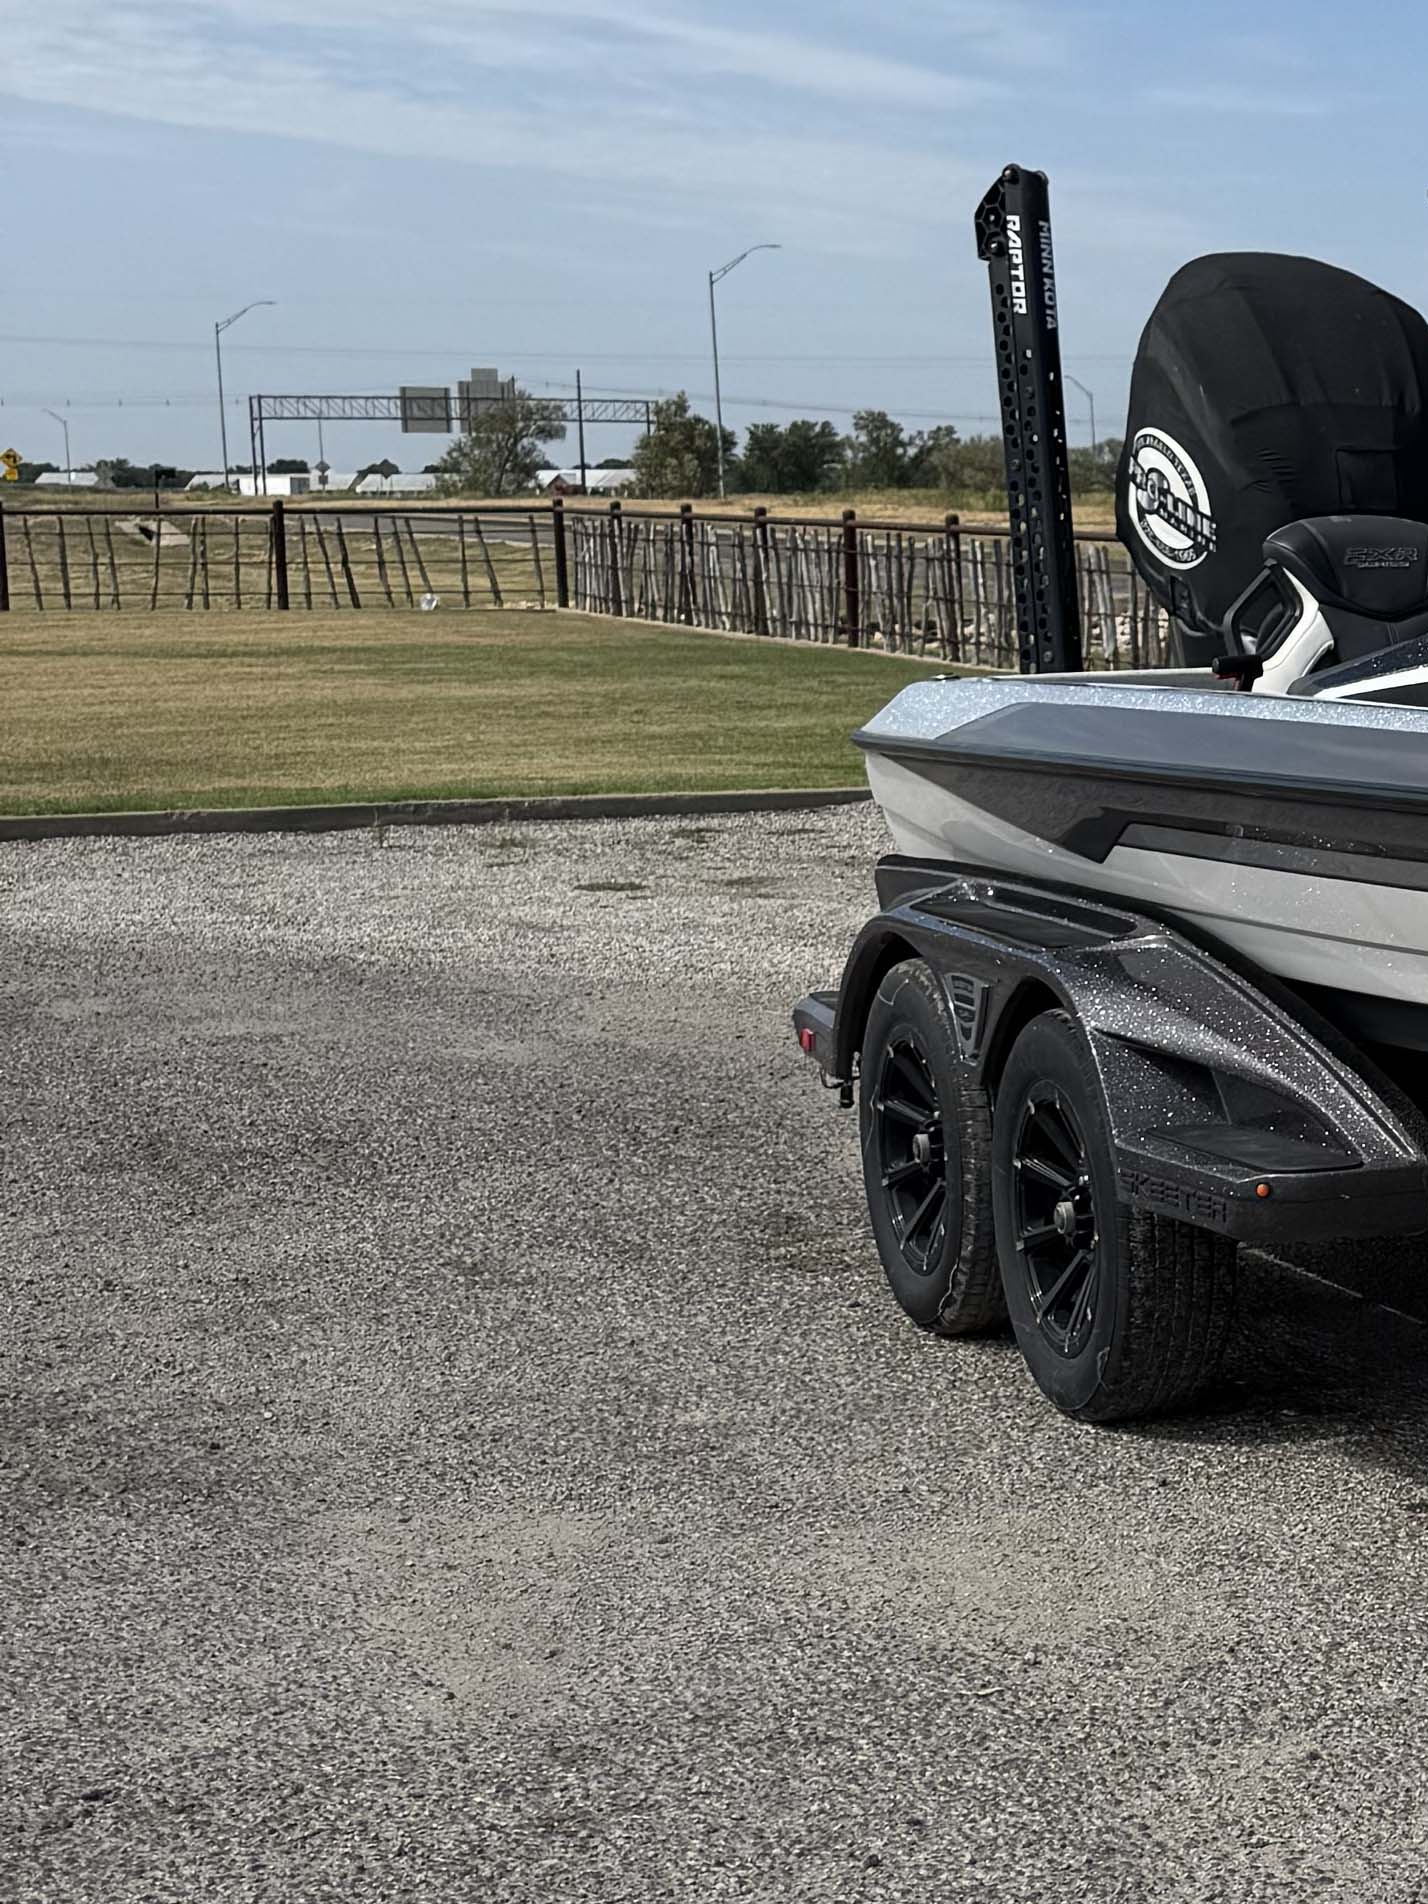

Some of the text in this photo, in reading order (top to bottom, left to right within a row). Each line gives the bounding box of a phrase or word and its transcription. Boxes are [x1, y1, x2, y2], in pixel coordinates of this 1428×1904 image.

[1006, 214, 1028, 314] RAPTOR
[1037, 219, 1058, 330] MINN KOTA
[1120, 1168, 1228, 1225] SKEETER
